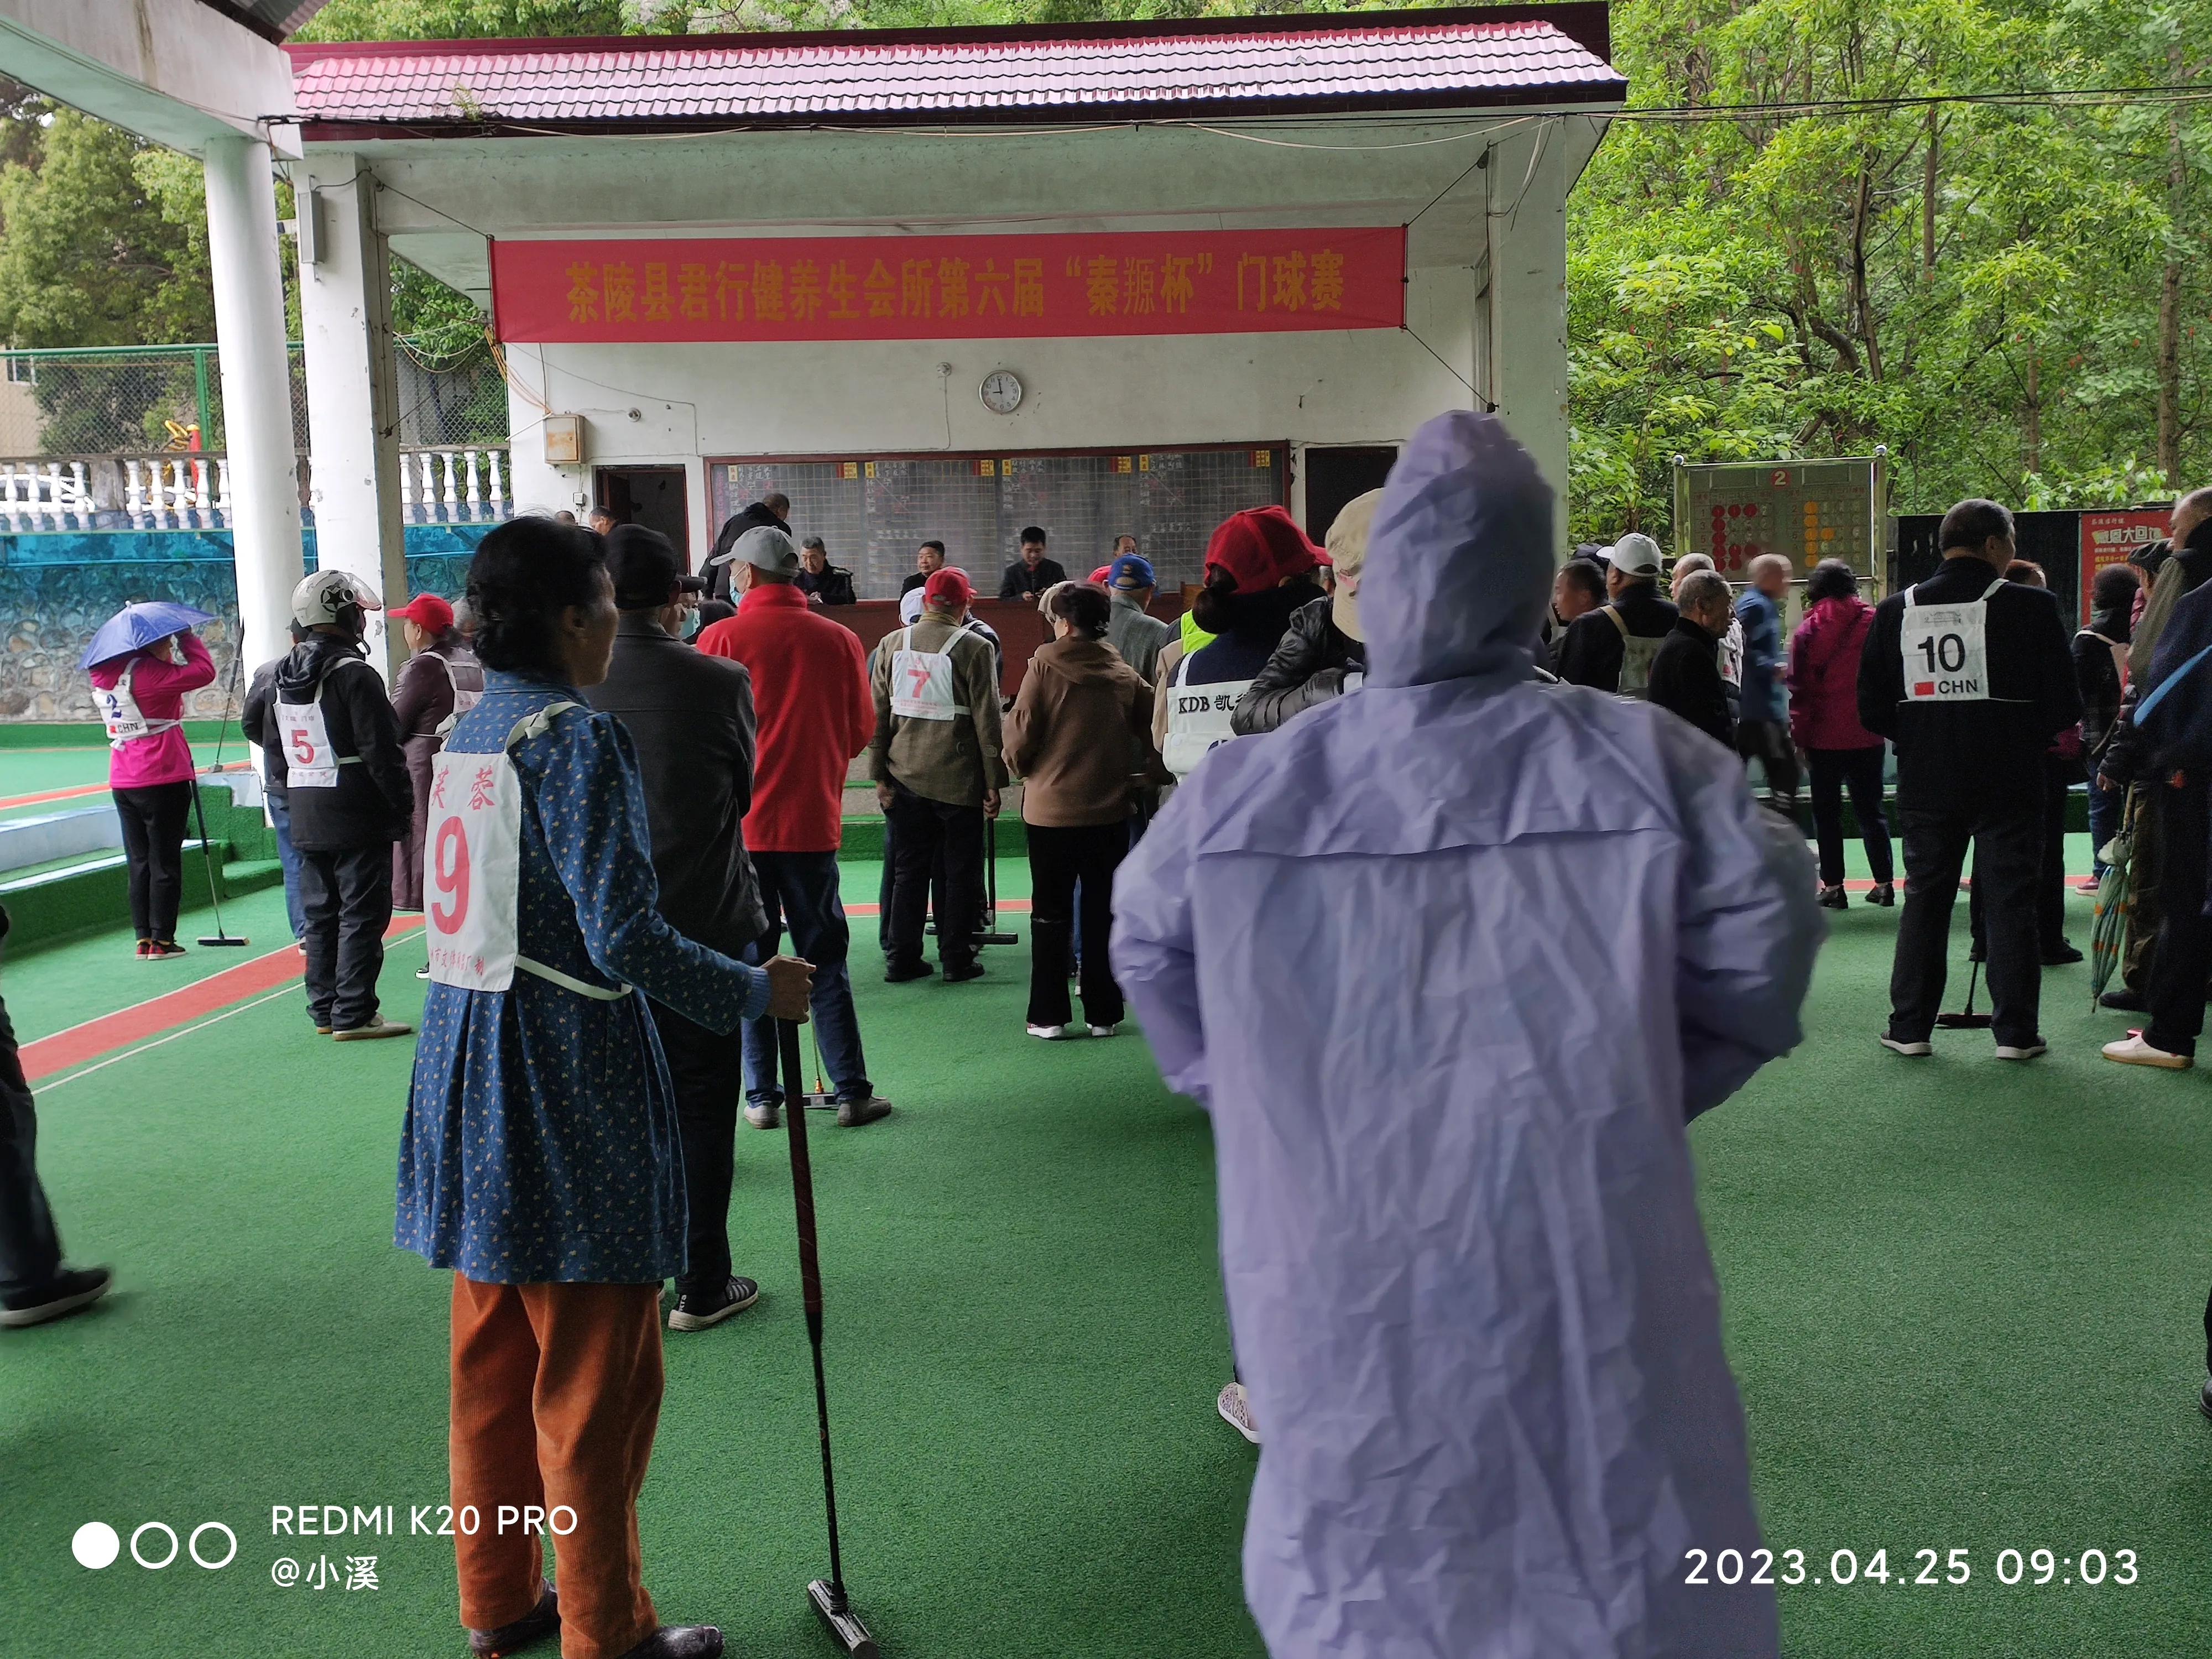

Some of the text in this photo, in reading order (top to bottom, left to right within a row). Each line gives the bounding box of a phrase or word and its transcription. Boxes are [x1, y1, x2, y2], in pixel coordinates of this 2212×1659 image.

[1775, 471, 1786, 485] 2
[1917, 633, 1965, 673] 10
[907, 669, 931, 698] 7
[1938, 679, 1978, 694] CHN
[106, 693, 122, 718] 2
[1178, 696, 1211, 714] KDB
[117, 722, 139, 733] CHN
[291, 729, 315, 764] 5
[431, 816, 471, 935] 9
